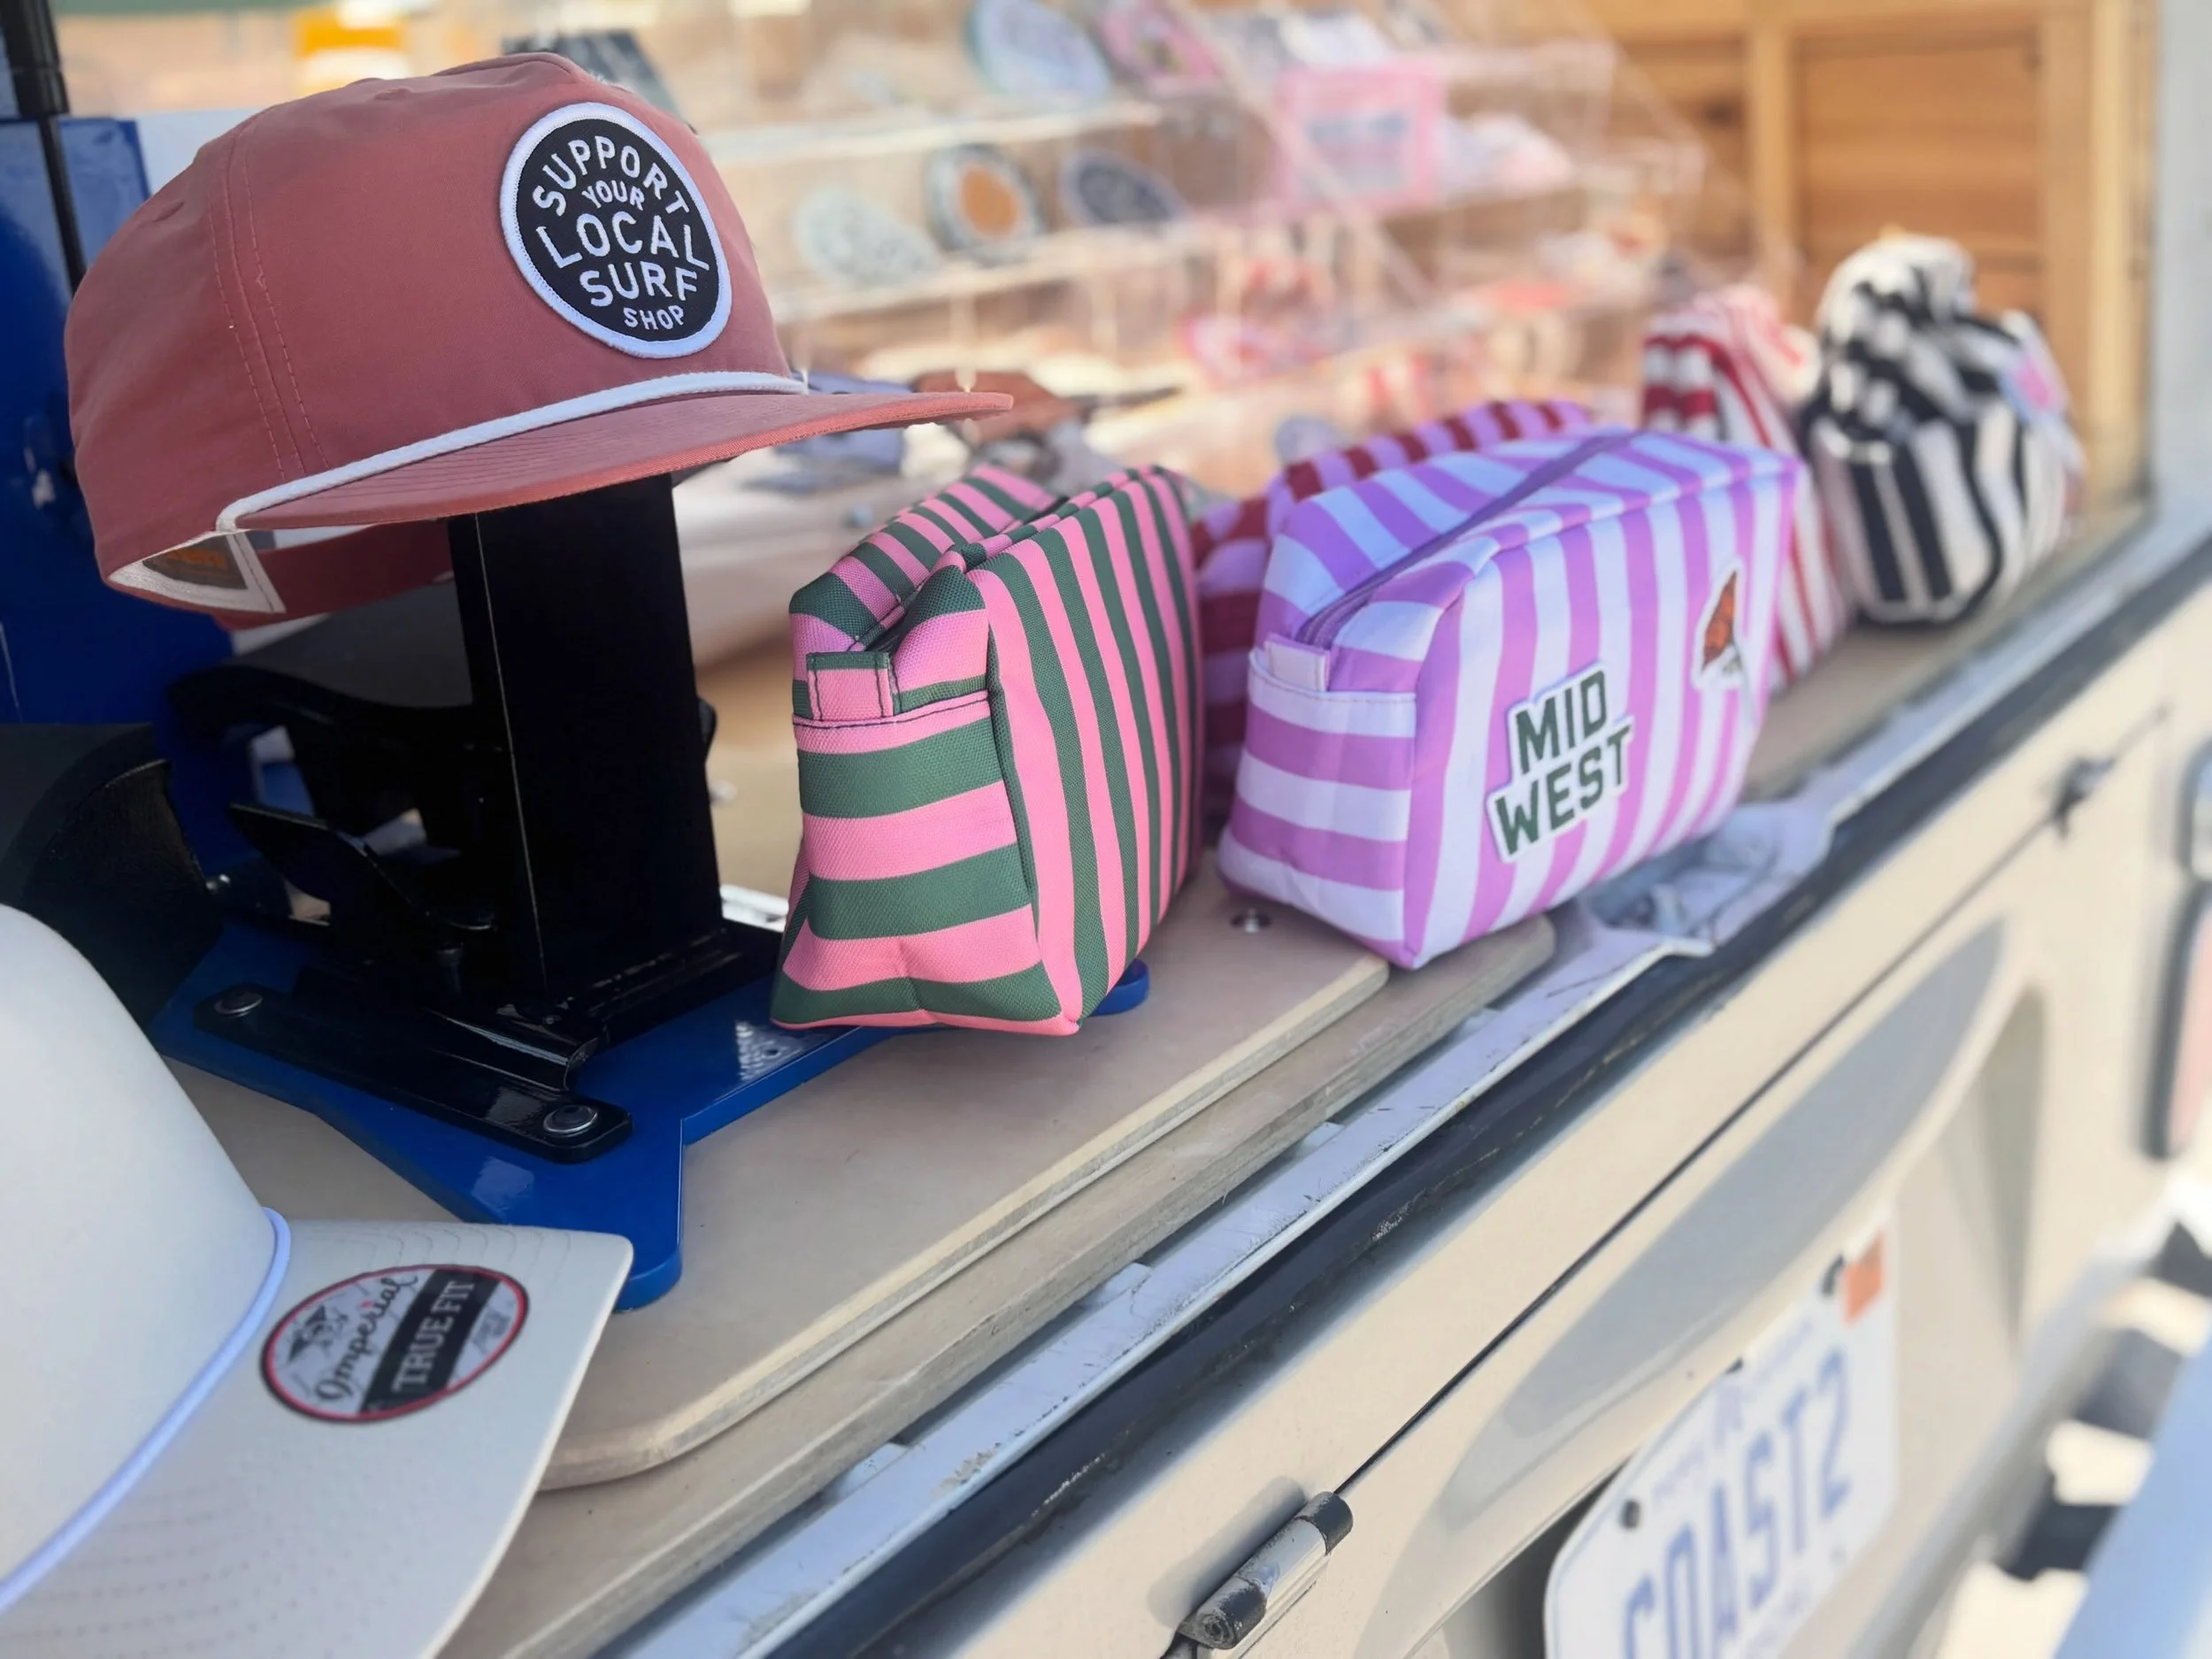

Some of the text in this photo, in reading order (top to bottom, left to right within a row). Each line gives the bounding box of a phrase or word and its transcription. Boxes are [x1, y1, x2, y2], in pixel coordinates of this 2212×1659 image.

[533, 135, 689, 217] SUPPORT
[581, 180, 645, 211] YOUR
[535, 211, 710, 271] LOCAL
[579, 261, 697, 307] SURF
[623, 304, 685, 330] SHOP
[1516, 670, 1608, 776] MID
[1494, 724, 1632, 856] WEST
[314, 1276, 419, 1401] Imperial
[391, 1280, 475, 1393] TRUE FIT
